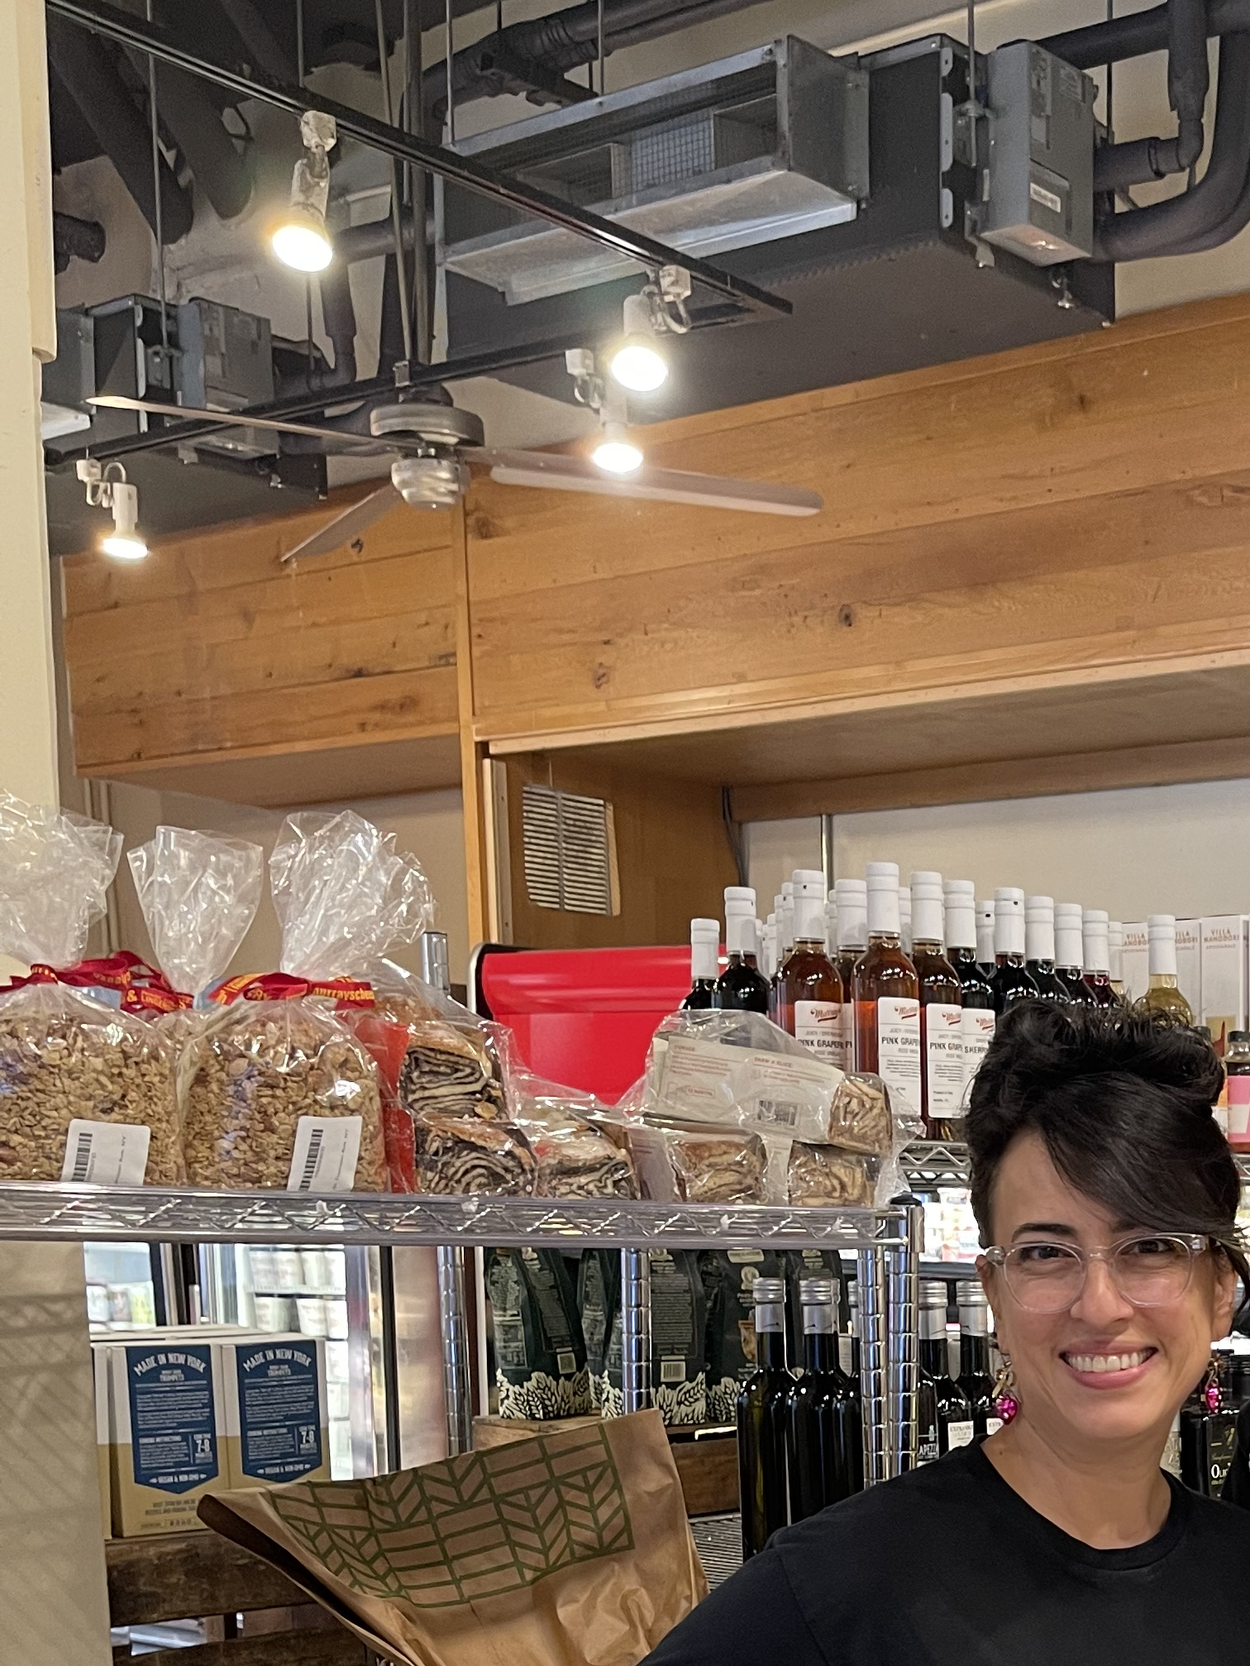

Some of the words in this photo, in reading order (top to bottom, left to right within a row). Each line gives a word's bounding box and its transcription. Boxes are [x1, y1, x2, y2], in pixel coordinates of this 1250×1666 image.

[881, 1037, 899, 1045] PINK
[929, 1042, 946, 1050] PINK
[133, 1357, 157, 1377] MADE
[168, 1353, 185, 1365] NEW
[187, 1356, 207, 1374] YORK
[243, 1353, 266, 1372] MADE
[275, 1349, 293, 1360] NEW
[293, 1351, 312, 1368] YORK
